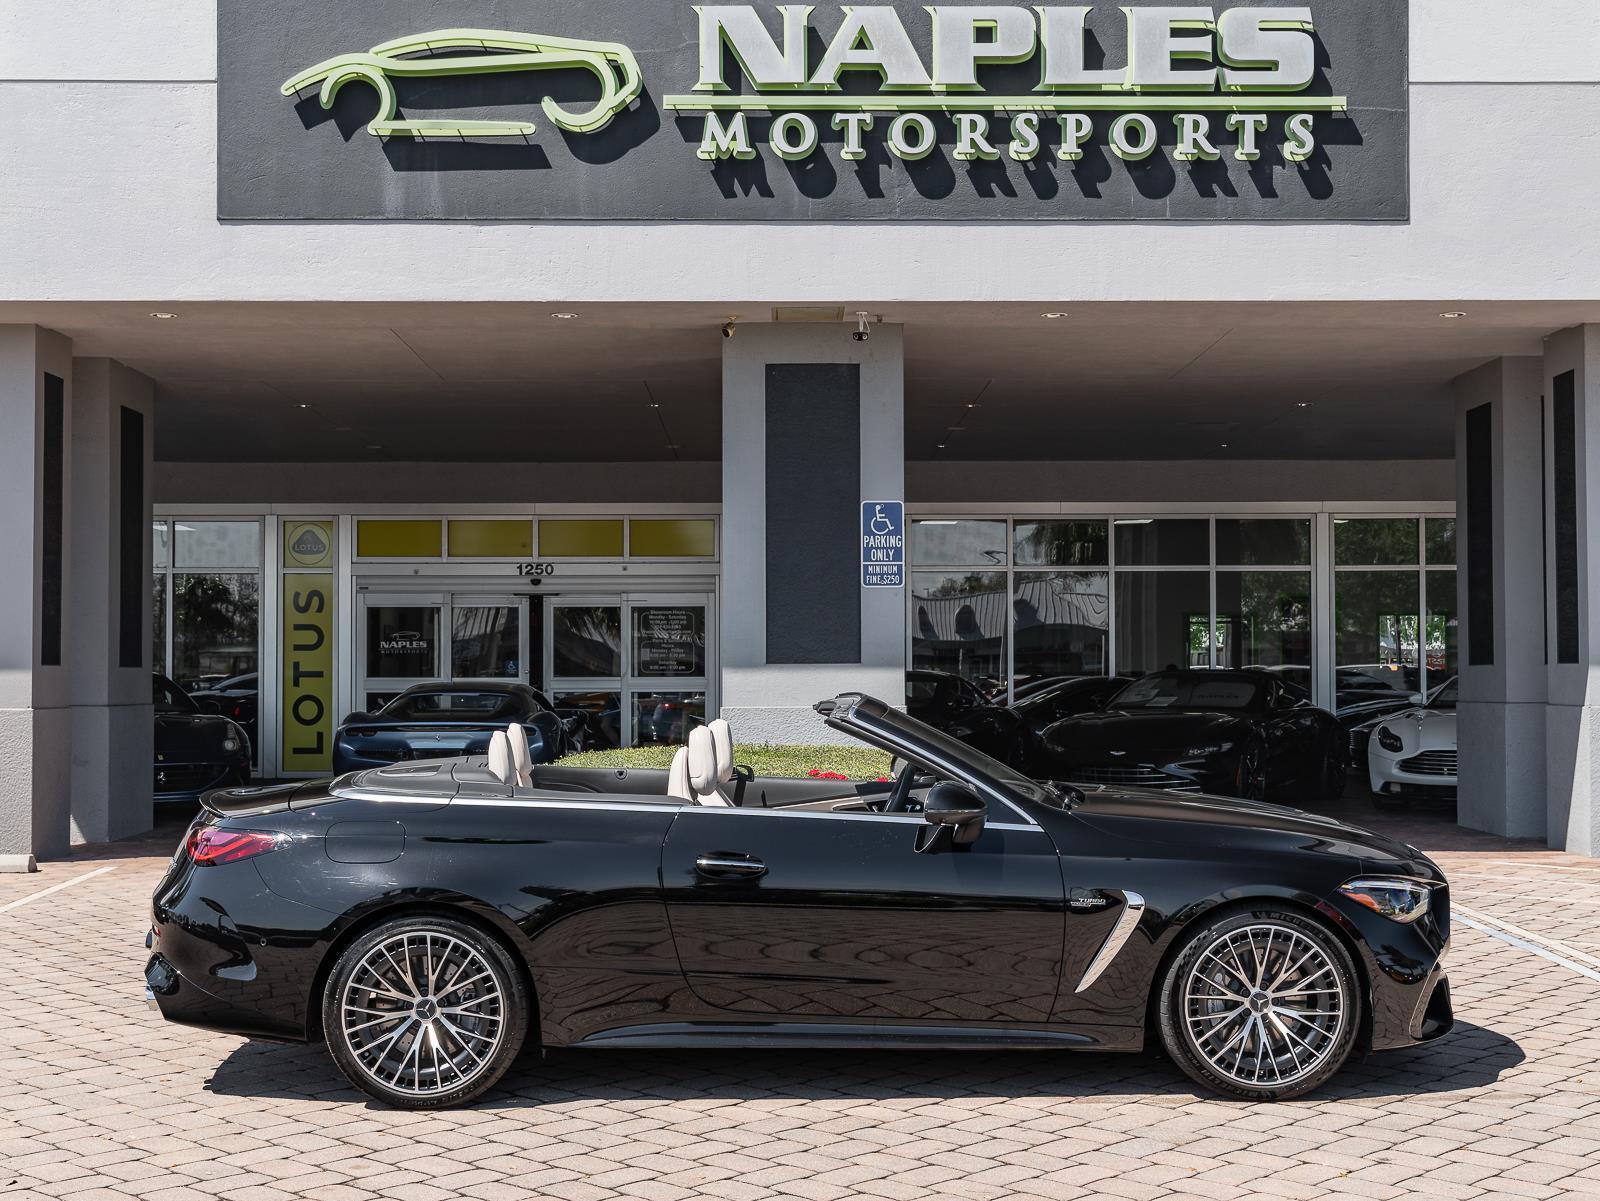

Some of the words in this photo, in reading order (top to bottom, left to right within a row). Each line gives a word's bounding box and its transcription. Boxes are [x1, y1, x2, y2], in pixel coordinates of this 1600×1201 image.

[691, 5, 1316, 92] NAPLES
[697, 112, 1316, 161] MOTORSPORTS
[863, 535, 902, 548] PARKING
[870, 549, 895, 561] ONLY
[516, 563, 554, 576] 1250
[868, 565, 898, 574] MINIMUM
[866, 575, 881, 584] FINE
[883, 575, 900, 585] $250
[292, 589, 325, 755] LOTUS
